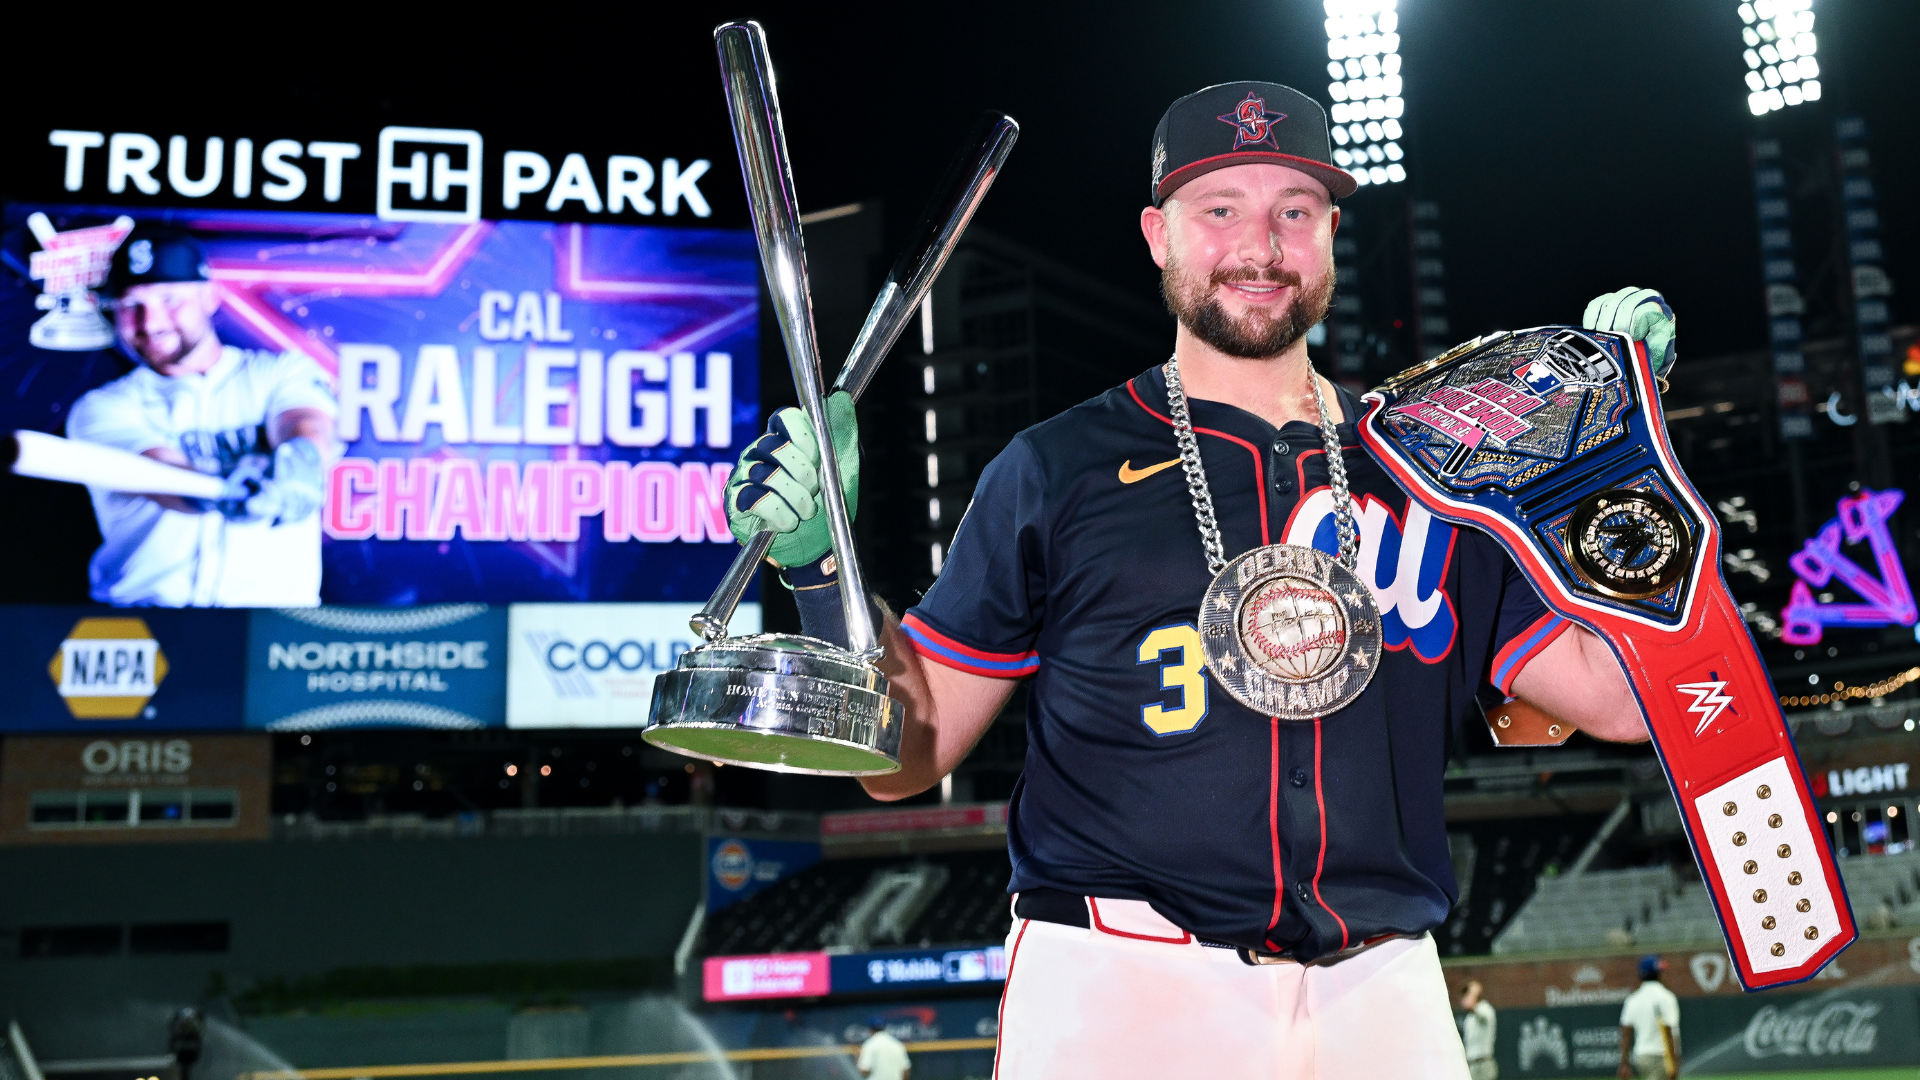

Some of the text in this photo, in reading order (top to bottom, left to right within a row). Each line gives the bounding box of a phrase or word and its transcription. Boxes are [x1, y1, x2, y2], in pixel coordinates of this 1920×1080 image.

[50, 130, 713, 217] TRUIST PARK
[480, 291, 573, 343] CAL
[338, 344, 732, 448] RALEIGH
[1466, 379, 1542, 417] DERBY
[323, 457, 735, 545] CHAMPION
[71, 646, 147, 687] NAPA
[268, 640, 488, 670] NORTHSIDE
[308, 671, 449, 692] HOSPITAL
[1137, 622, 1209, 738] 3
[82, 739, 192, 772] ORIS
[1828, 762, 1910, 797] LIGHT
